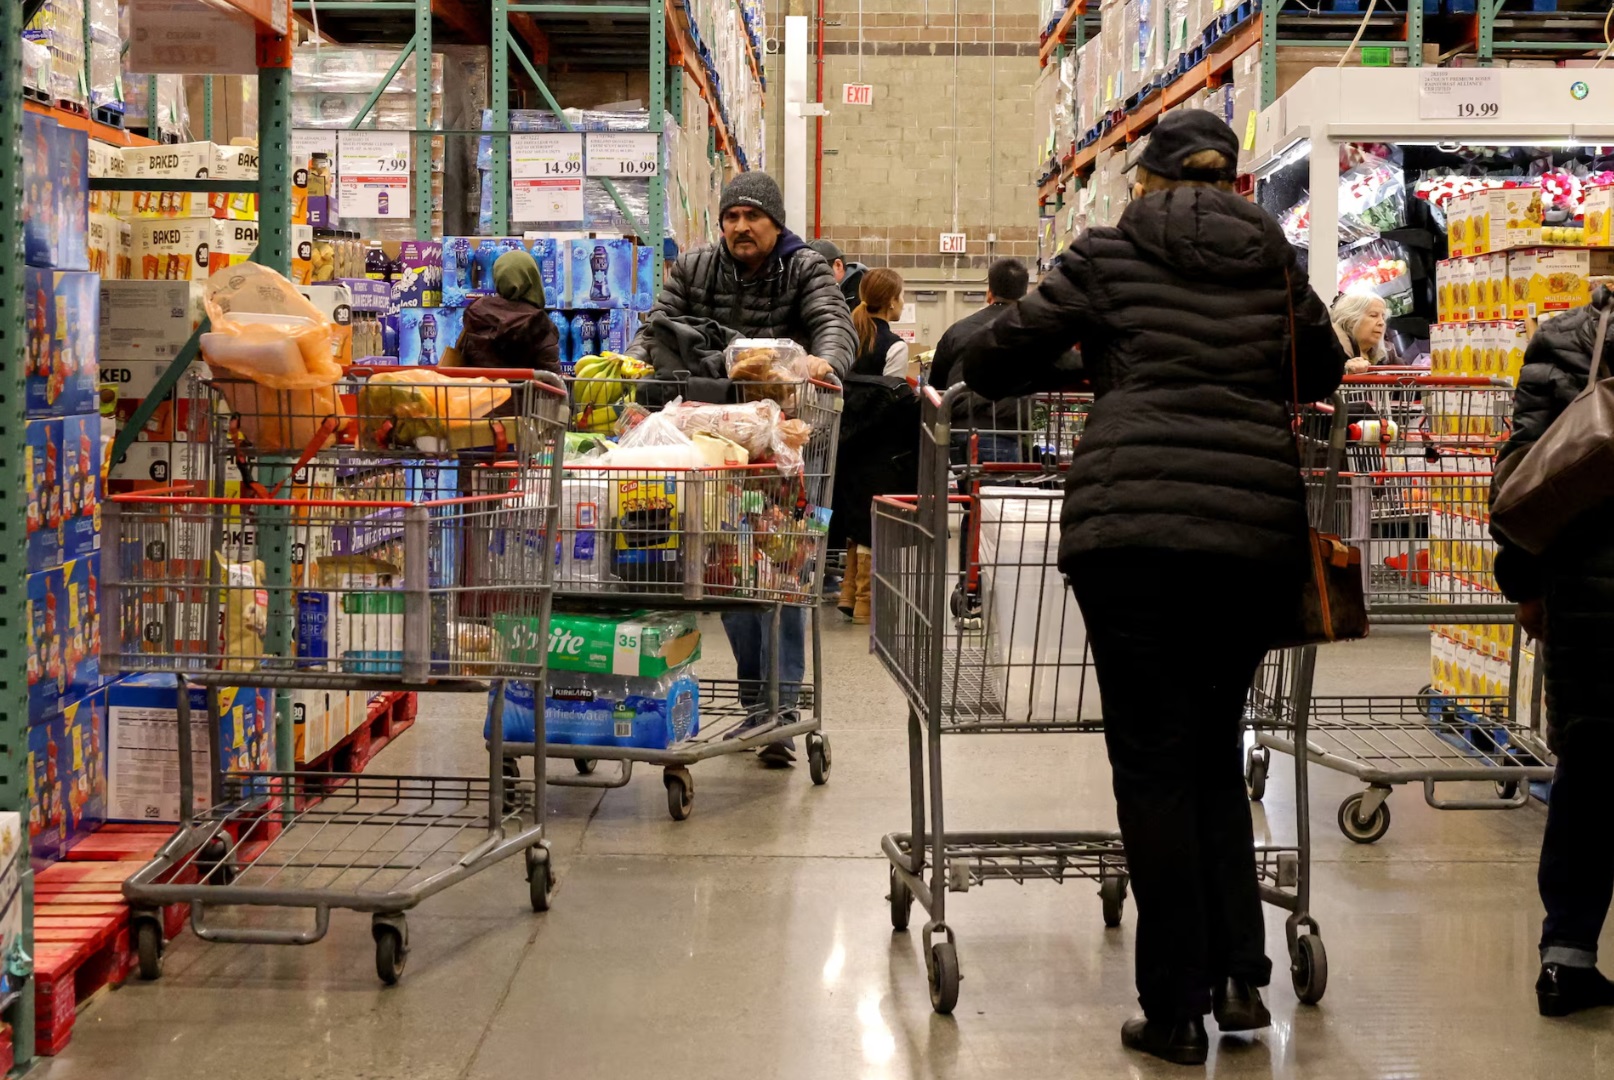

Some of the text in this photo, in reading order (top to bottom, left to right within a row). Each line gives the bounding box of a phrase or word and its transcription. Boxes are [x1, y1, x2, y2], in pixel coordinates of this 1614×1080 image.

[847, 86, 870, 104] EXIT
[1457, 103, 1498, 117] 19.99
[110, 157, 125, 172] BAKE
[149, 154, 179, 170] BAKED
[238, 153, 258, 168] BAK
[377, 159, 407, 172] 7.99
[545, 161, 581, 174] 14.99
[619, 161, 656, 174] 10.99
[153, 230, 181, 245] BAKED
[234, 227, 259, 241] BAK
[301, 245, 311, 254] 30
[943, 236, 963, 251] EXIT
[338, 309, 348, 318] 30
[100, 369, 131, 382] KED
[154, 465, 165, 477] 30
[621, 482, 638, 492] GAD
[222, 531, 254, 545] AKE
[300, 613, 328, 623] CHICK
[300, 624, 324, 635] BREA
[512, 624, 585, 655] Spite
[619, 634, 636, 648] 35
[294, 706, 303, 718] 30
[545, 710, 608, 721] urified water
